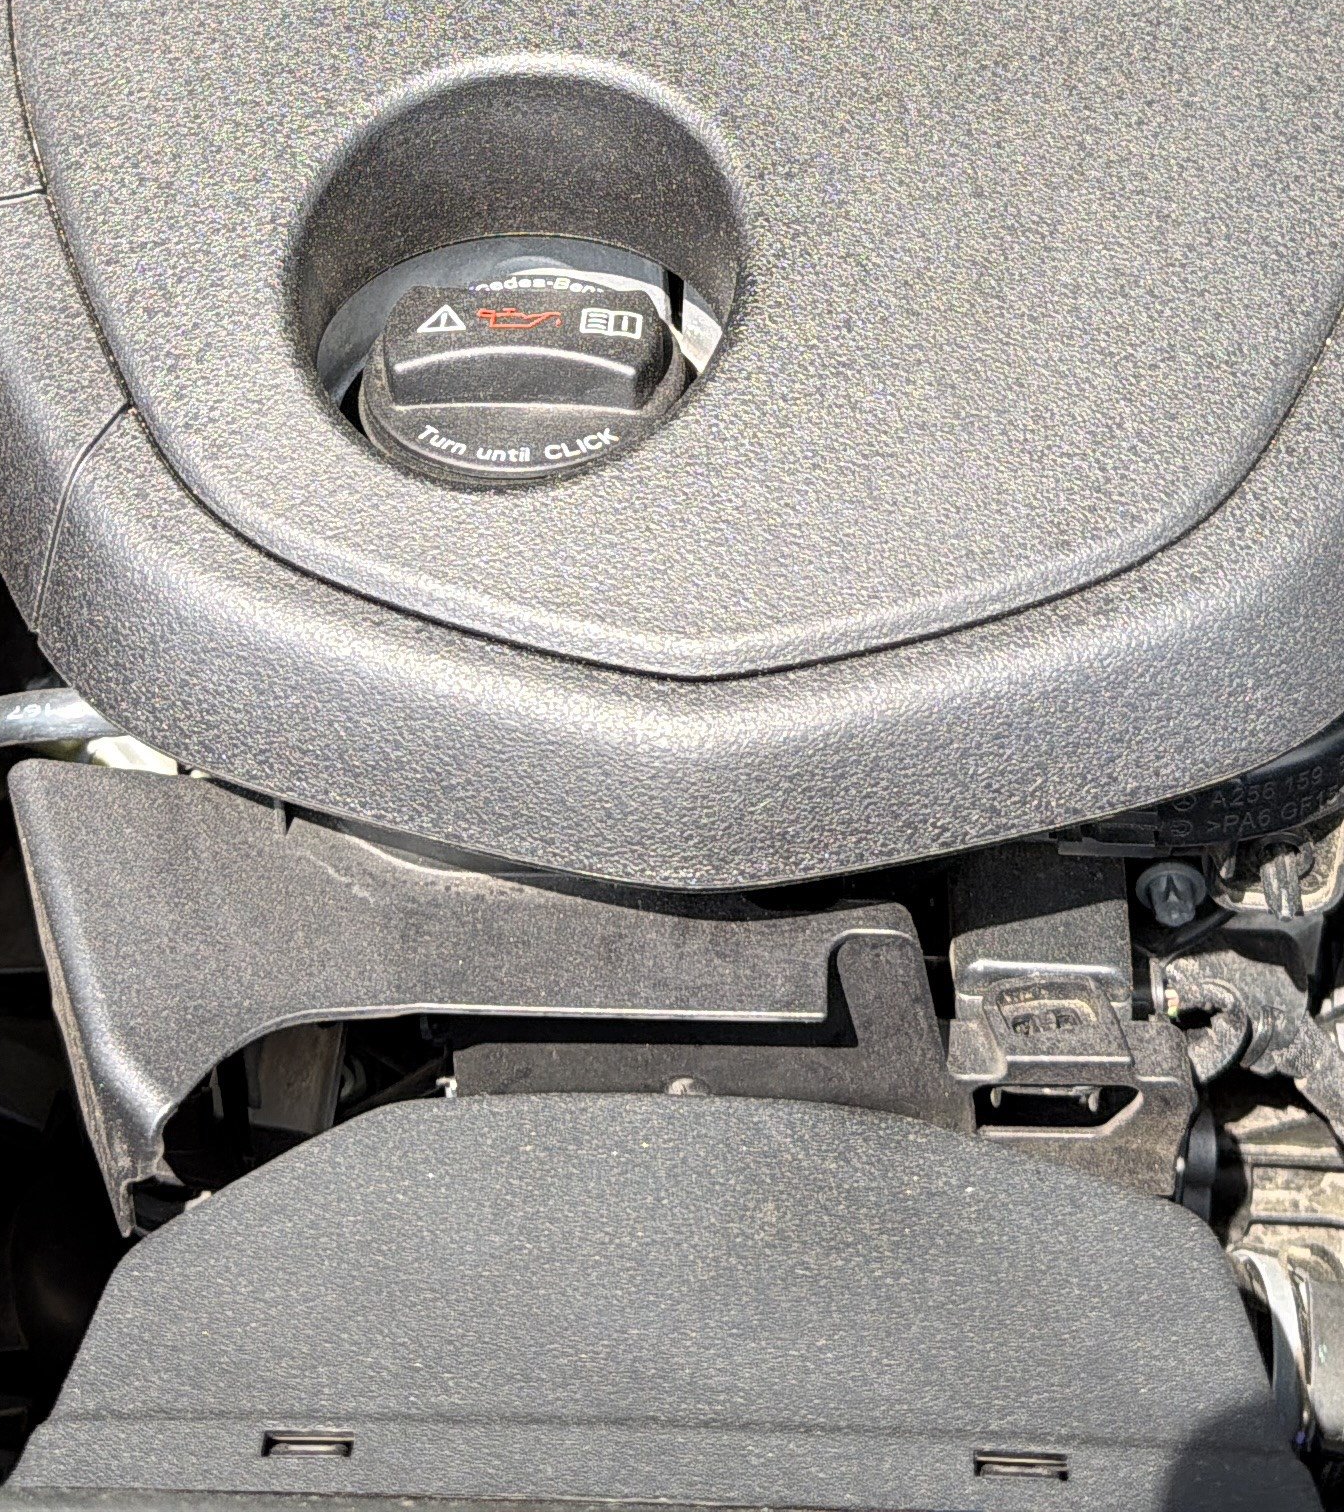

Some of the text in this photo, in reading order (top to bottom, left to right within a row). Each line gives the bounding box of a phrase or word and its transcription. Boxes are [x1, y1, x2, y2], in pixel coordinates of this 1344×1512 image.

[417, 424, 620, 463] Turn until CLICK
